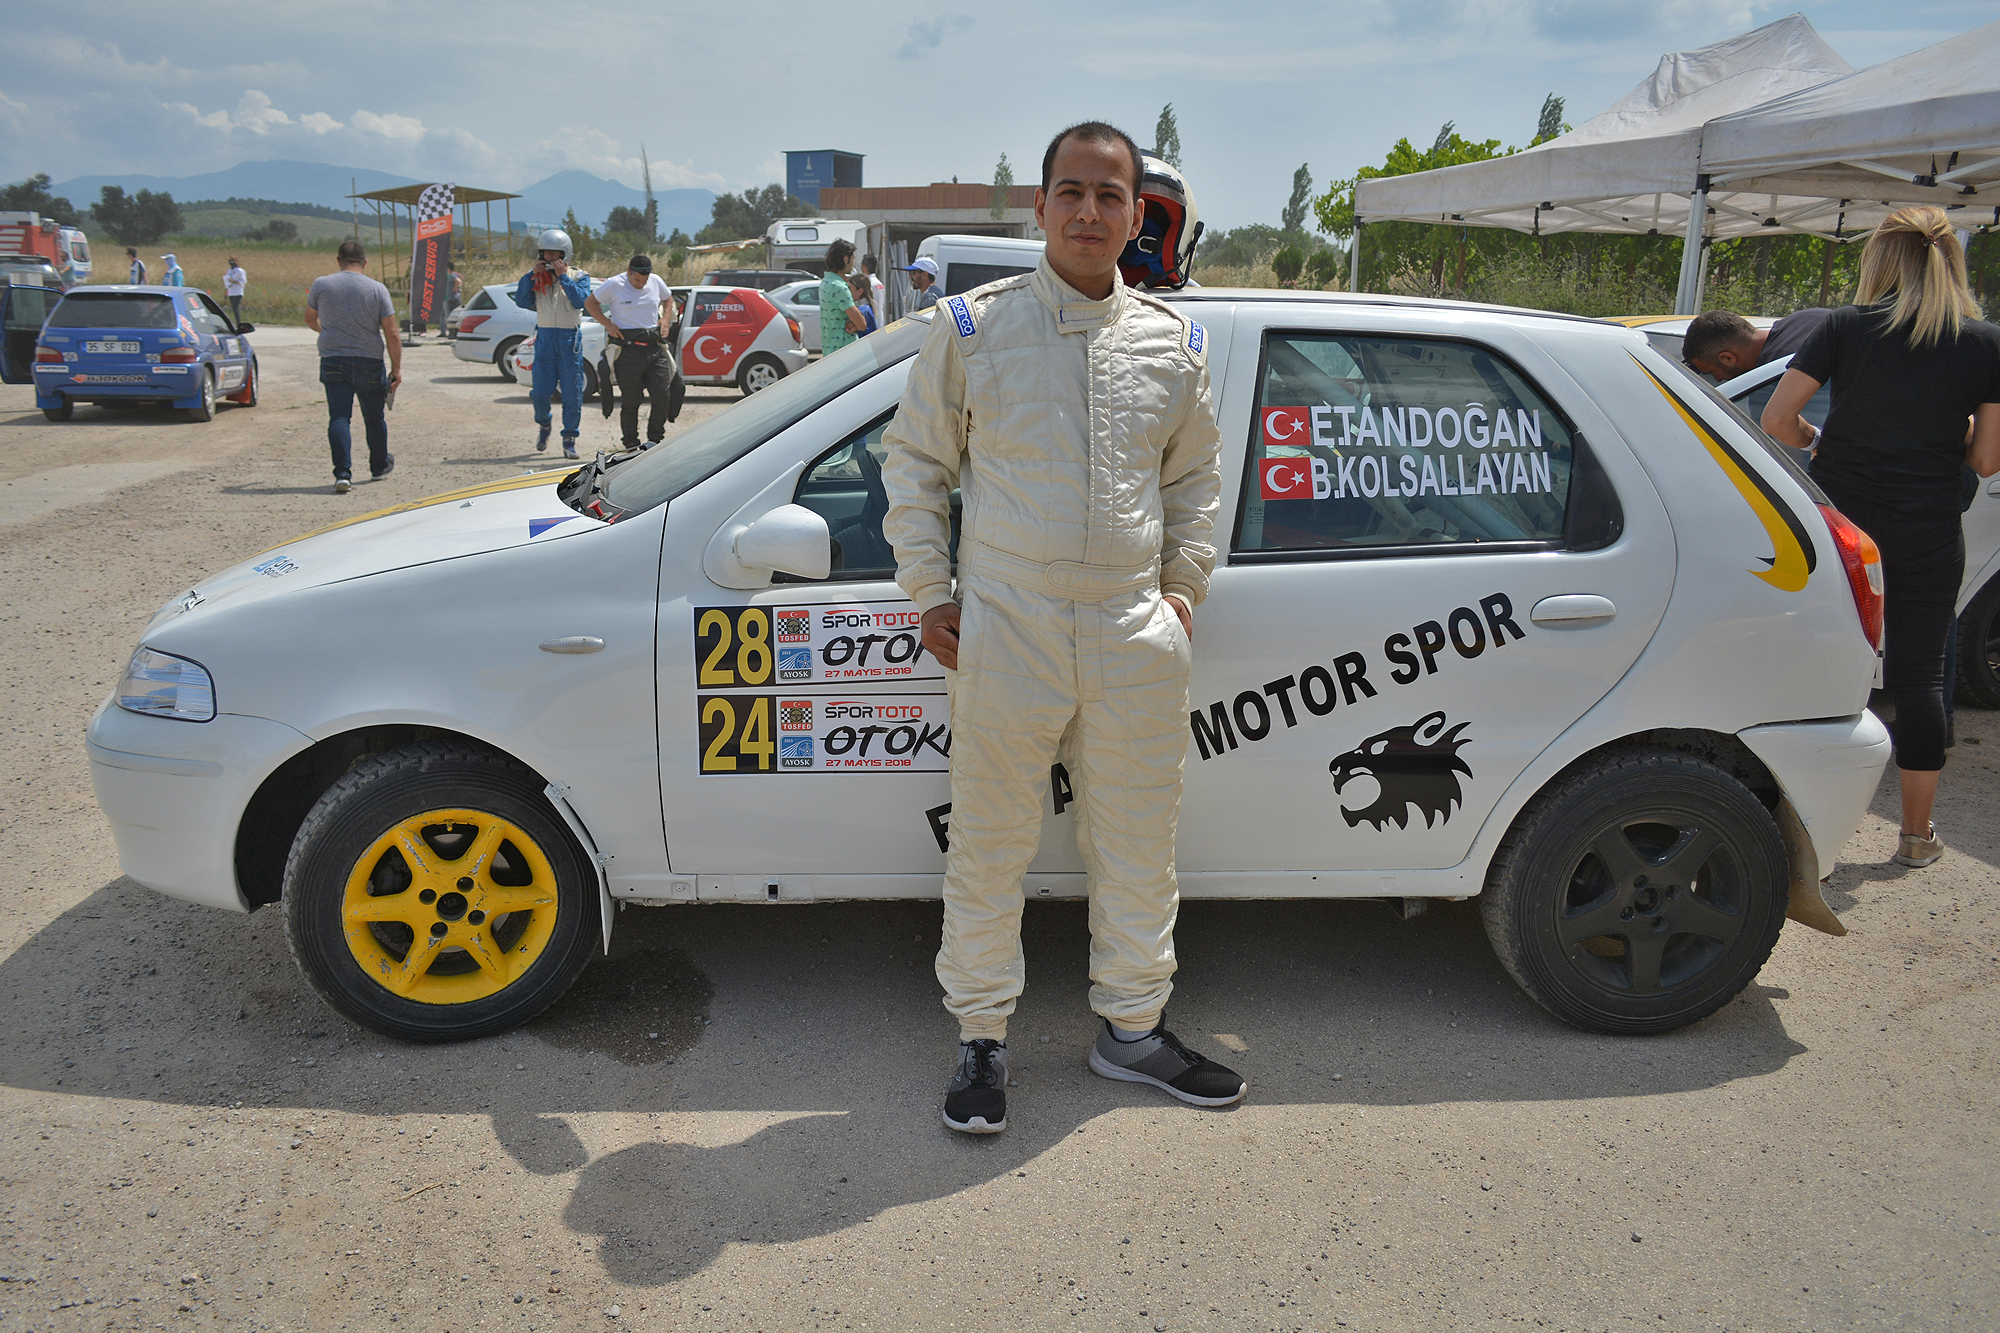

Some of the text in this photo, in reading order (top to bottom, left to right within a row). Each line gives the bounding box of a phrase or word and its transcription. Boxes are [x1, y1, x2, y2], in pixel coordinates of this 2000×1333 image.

[425, 238, 439, 280] SERVIS
[421, 280, 435, 311] BEST
[704, 303, 745, 312] T.TEZEKEN
[716, 312, 727, 320] B+
[87, 342, 138, 352] 35 SF 023
[1310, 402, 1542, 449] E.TANDOĞAN
[1311, 451, 1551, 500] B.KOLSALLAYAN
[779, 634, 809, 642] TOSFED
[698, 608, 772, 685] 28
[783, 670, 809, 678] AYOSK
[825, 667, 912, 678] 27 MAYIS 2018
[1190, 591, 1527, 761] MOTOR SPOR
[701, 697, 775, 771] 24
[785, 758, 810, 766] AYOSK
[826, 759, 912, 767] 27 MAYIS 2018
